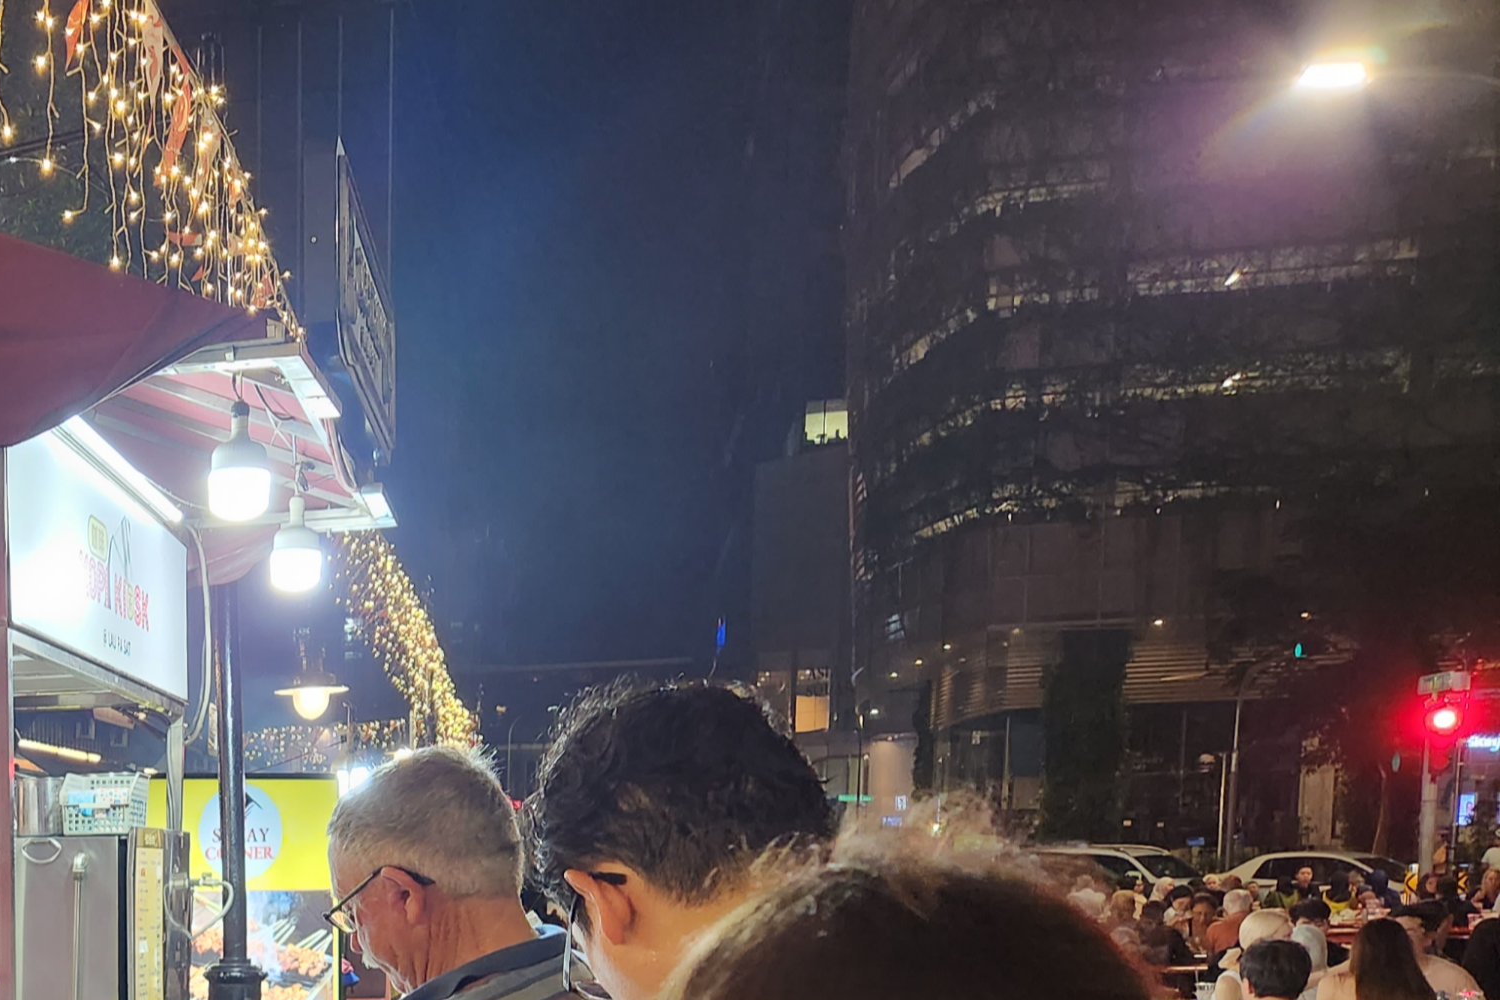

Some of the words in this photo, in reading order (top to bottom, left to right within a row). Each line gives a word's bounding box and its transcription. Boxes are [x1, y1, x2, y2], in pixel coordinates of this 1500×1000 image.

[79, 549, 112, 610] OPI
[114, 572, 150, 632] KIOSK
[211, 828, 270, 844] SAY
[205, 846, 275, 860] CNER
